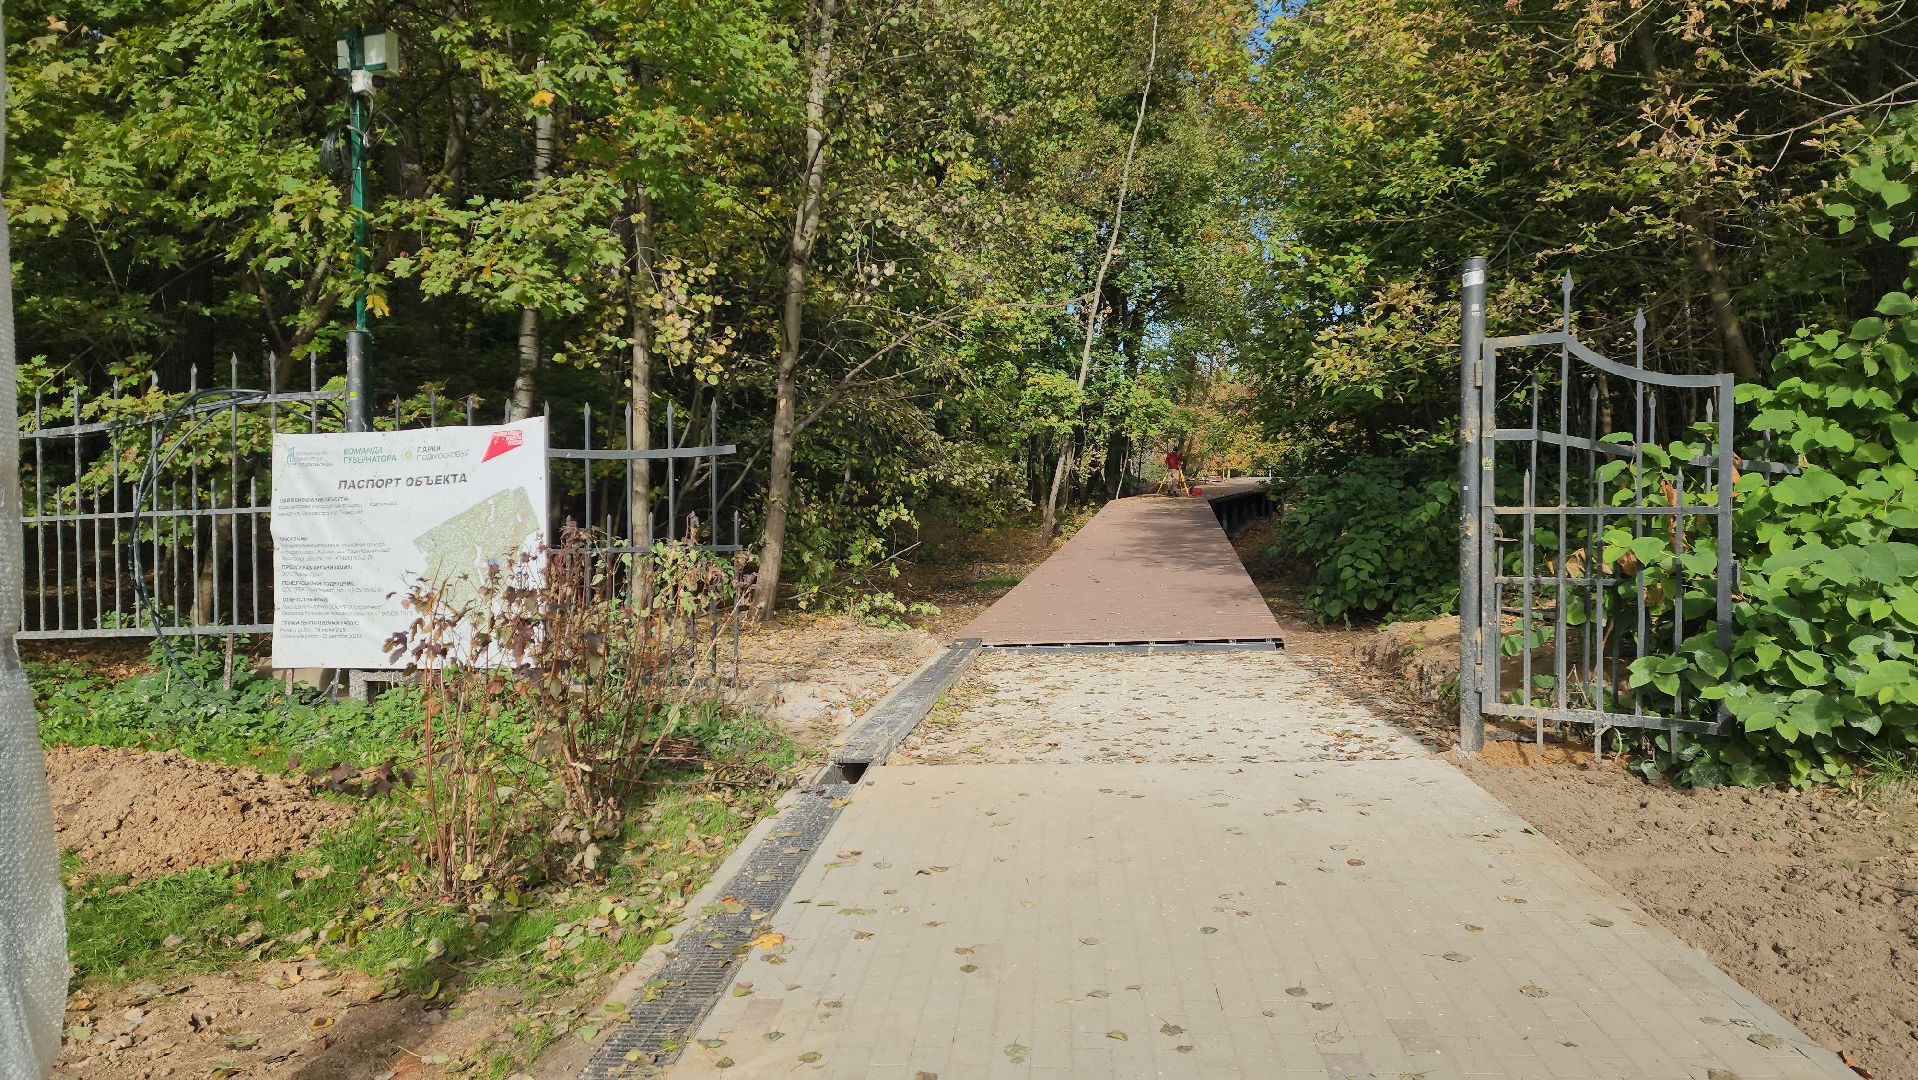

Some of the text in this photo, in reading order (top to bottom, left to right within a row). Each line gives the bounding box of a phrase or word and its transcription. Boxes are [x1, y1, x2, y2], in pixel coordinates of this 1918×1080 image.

[343, 446, 383, 455] КОМАНДА
[343, 454, 397, 464] ГУБЕРНАТОРА
[338, 473, 468, 490] ПАСПОРТ ОБЪЕКТА
